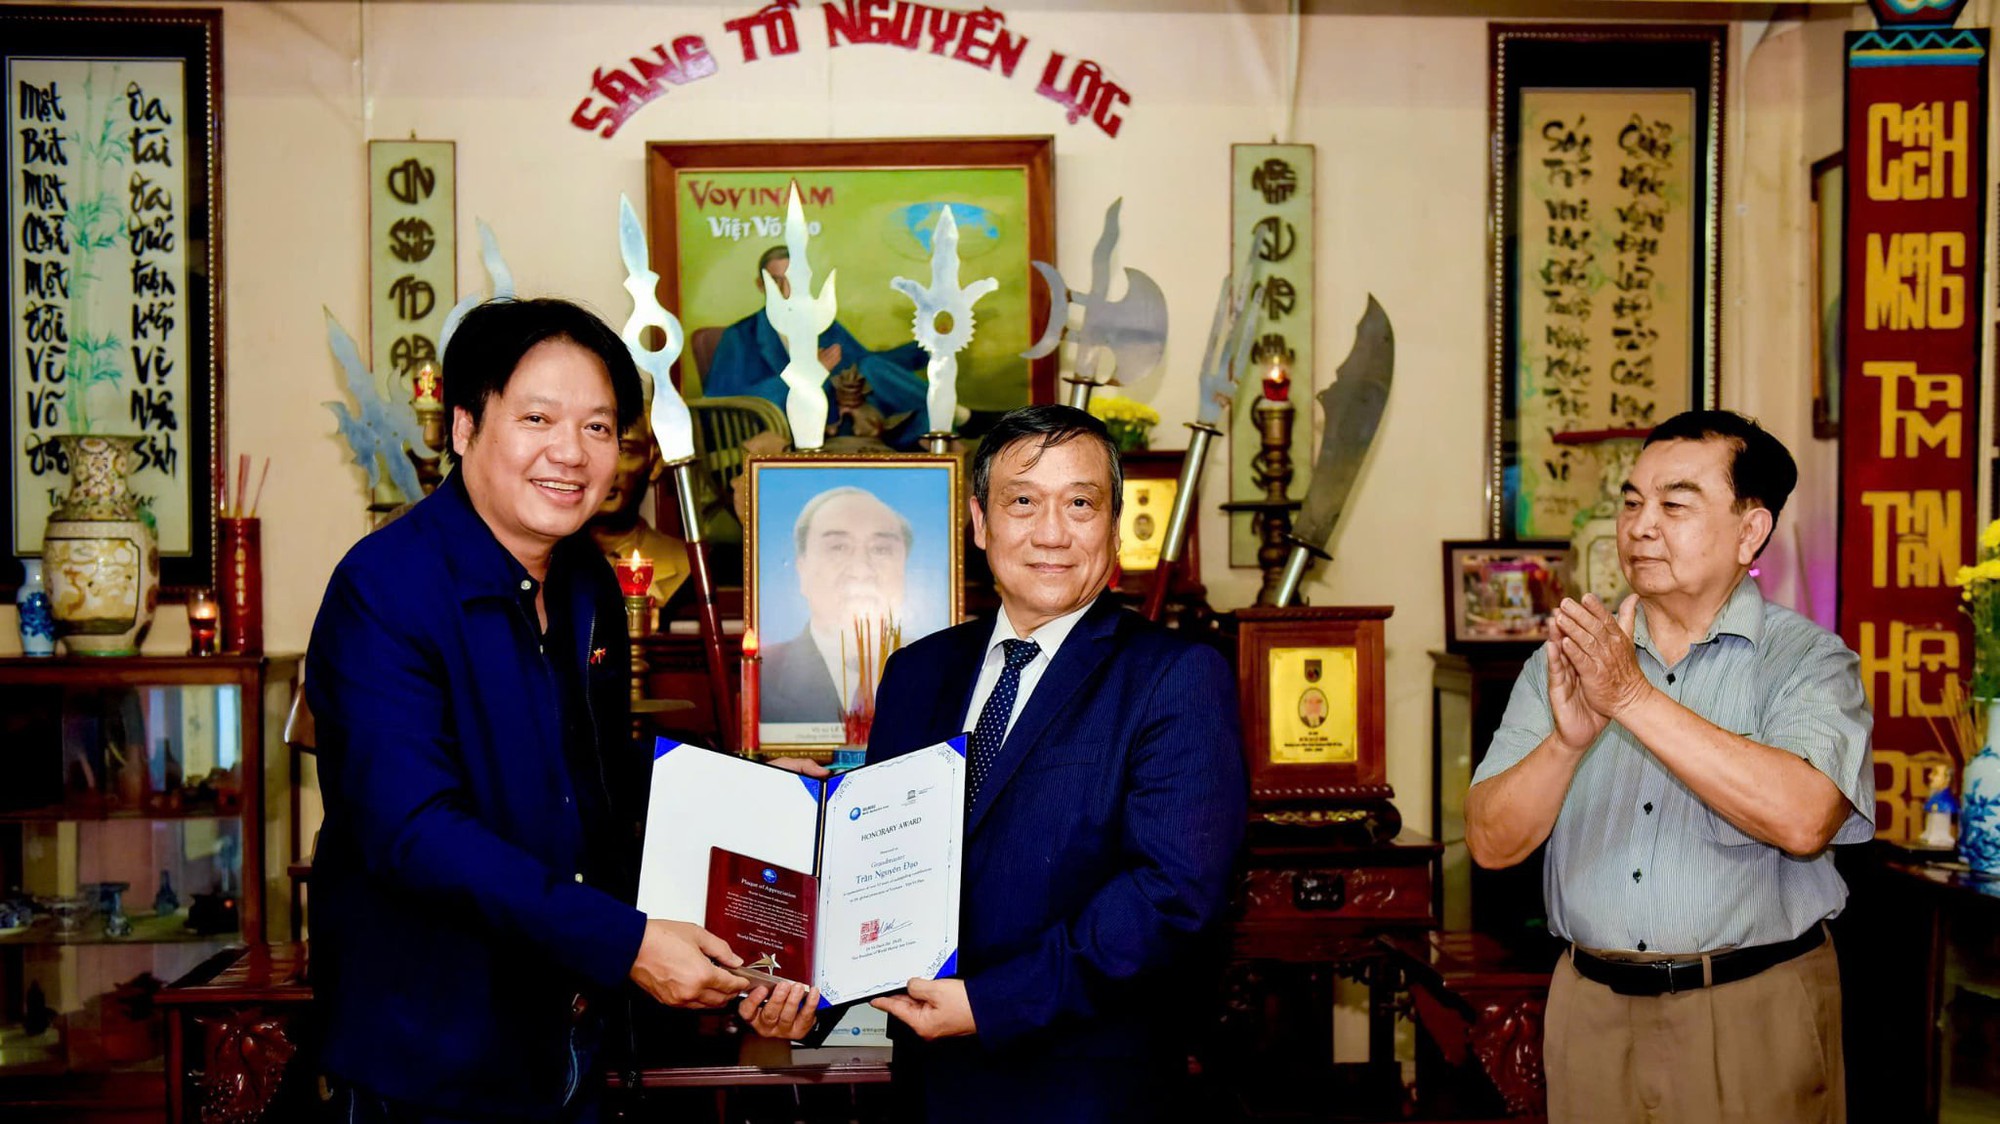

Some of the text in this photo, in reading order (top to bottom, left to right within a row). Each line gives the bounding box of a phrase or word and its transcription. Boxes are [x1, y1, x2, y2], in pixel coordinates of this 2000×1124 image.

[569, 0, 1132, 140] SÁNG TỔ NGUYỄN LỘC
[19, 80, 66, 122] Một
[21, 168, 69, 211] Một
[687, 176, 835, 212] VOVINAM
[24, 257, 70, 300] Một
[27, 386, 66, 430] Võ
[860, 816, 922, 842] HONORARY AWARD
